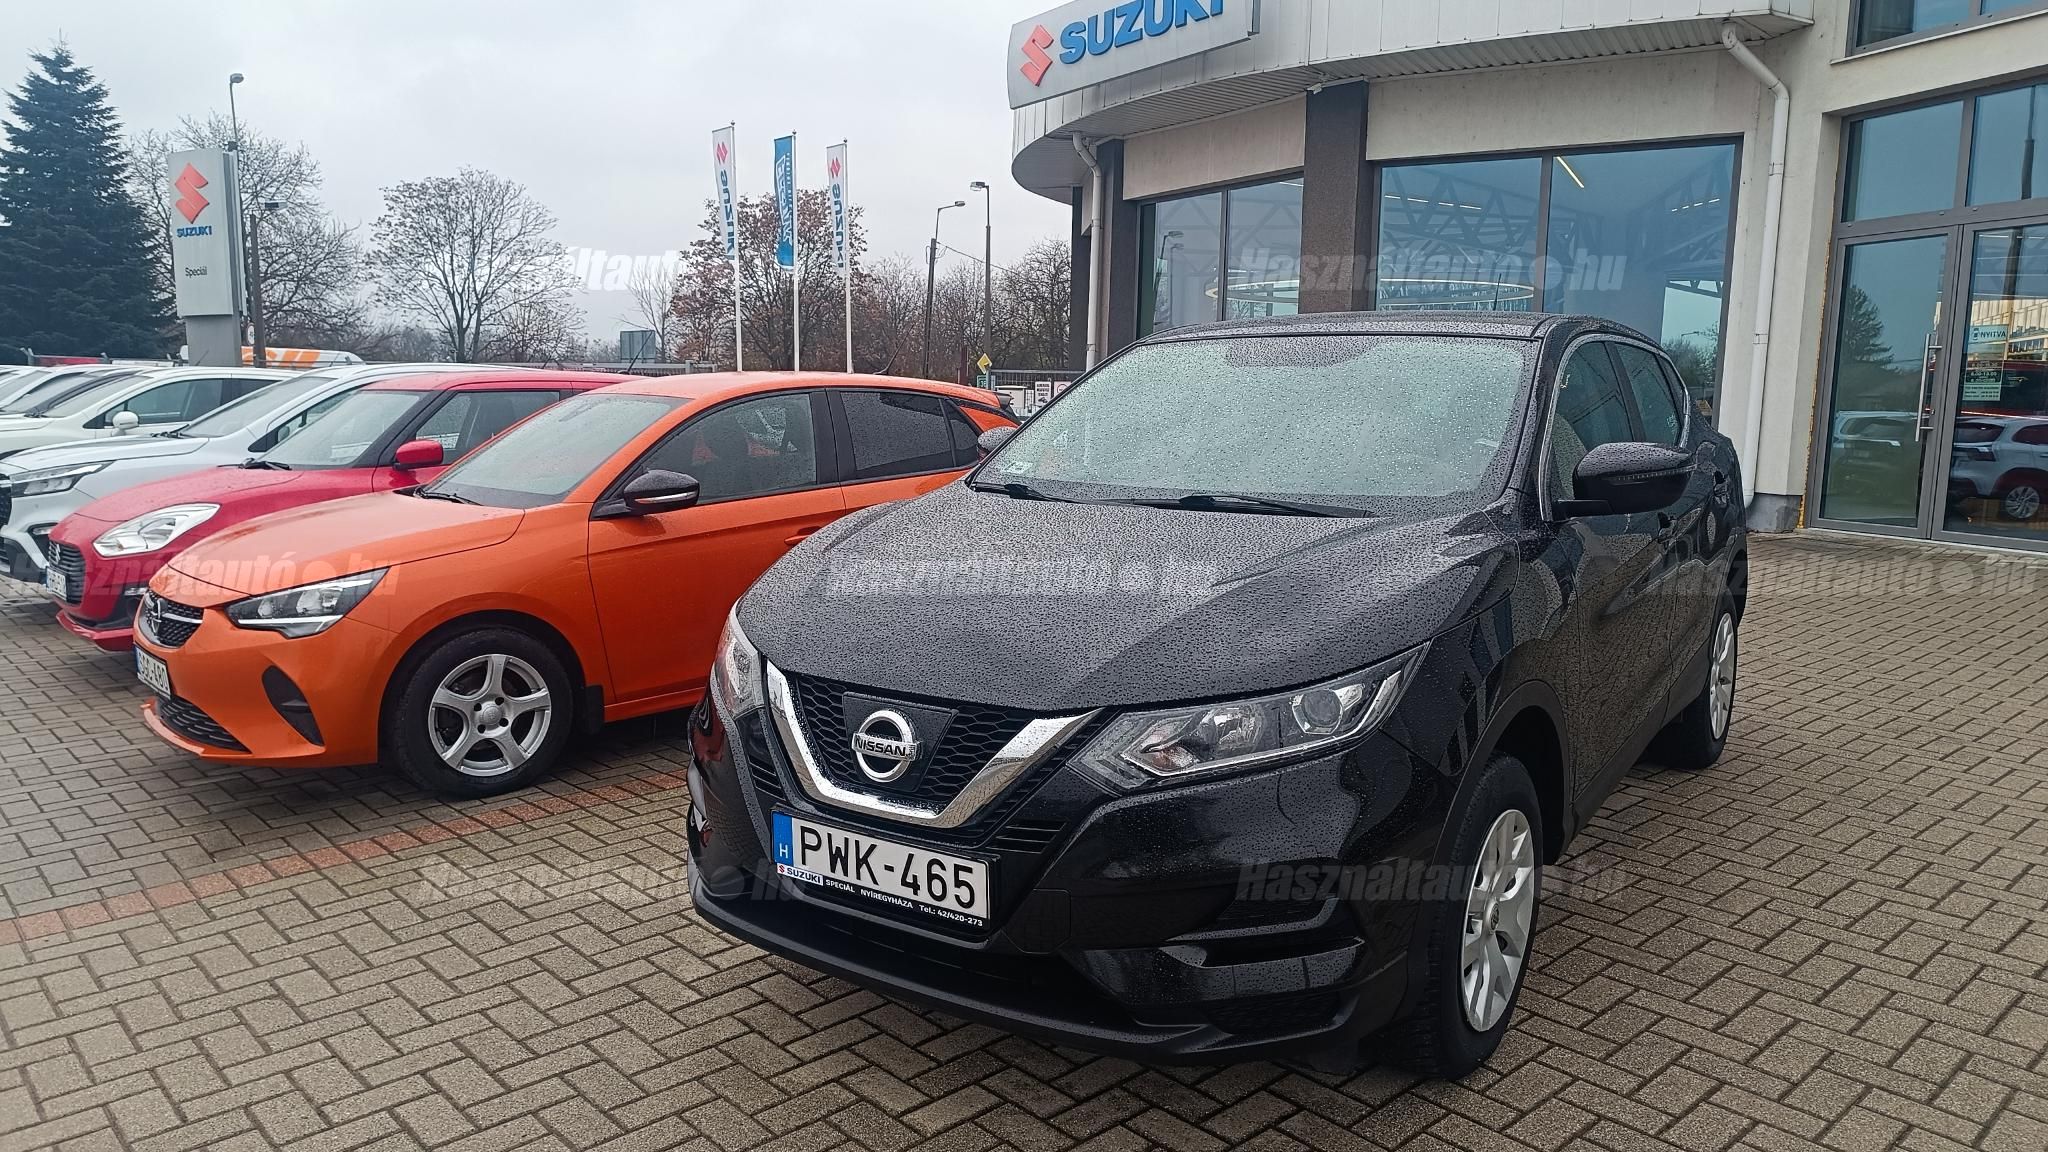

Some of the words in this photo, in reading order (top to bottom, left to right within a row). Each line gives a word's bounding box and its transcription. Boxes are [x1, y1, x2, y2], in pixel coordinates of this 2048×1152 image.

[176, 225, 213, 238] SUZUKI
[1980, 330, 2007, 338] NYITVA
[855, 735, 907, 757] NISSAN
[779, 842, 789, 859] H
[800, 825, 975, 909] PWK-465
[786, 866, 822, 885] SUZUKI
[825, 878, 856, 893] SPECIÁL
[860, 887, 914, 910] NYÍREGYHÁZA
[919, 903, 936, 916] Tel.:
[936, 907, 984, 928] 42/420-273
